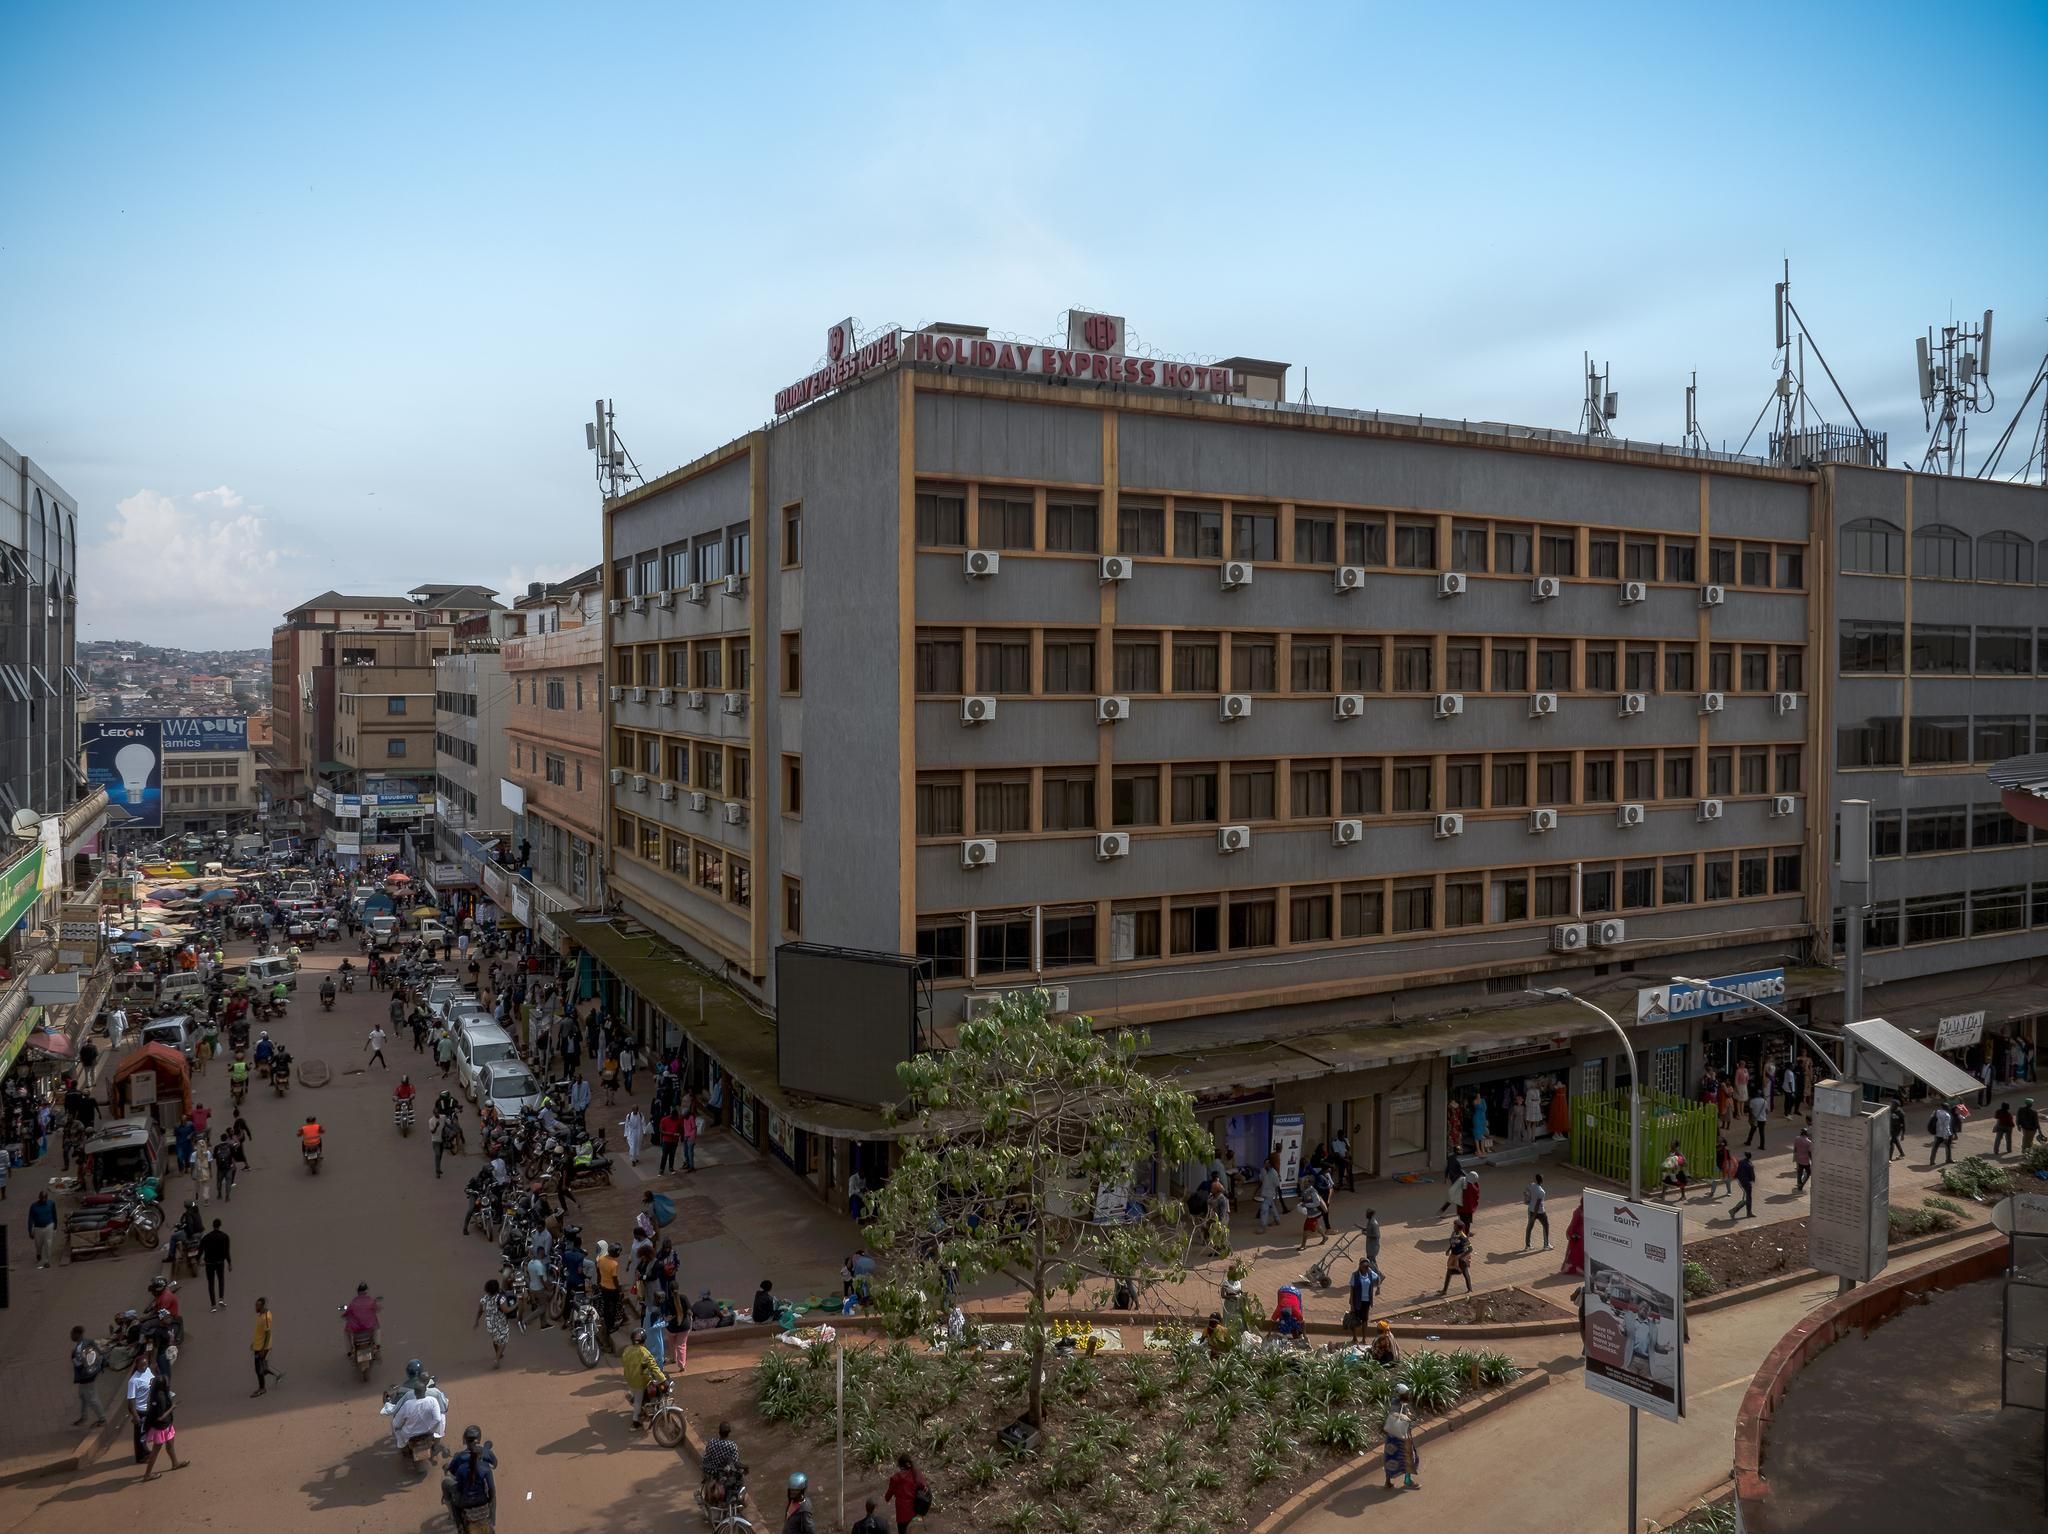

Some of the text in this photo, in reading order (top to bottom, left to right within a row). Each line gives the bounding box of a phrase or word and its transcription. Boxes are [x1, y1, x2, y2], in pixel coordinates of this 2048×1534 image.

[810, 353, 858, 396] EXPRESS
[857, 332, 898, 373] HOTEL
[917, 333, 1235, 394] HOLIDAY EXPRESS HOTEL
[163, 719, 201, 736] WA
[163, 738, 201, 748] amics
[1671, 989, 1705, 1013] DRY
[1707, 976, 1785, 1007] CLEANERS
[1613, 1215, 1640, 1228] EQUITY
